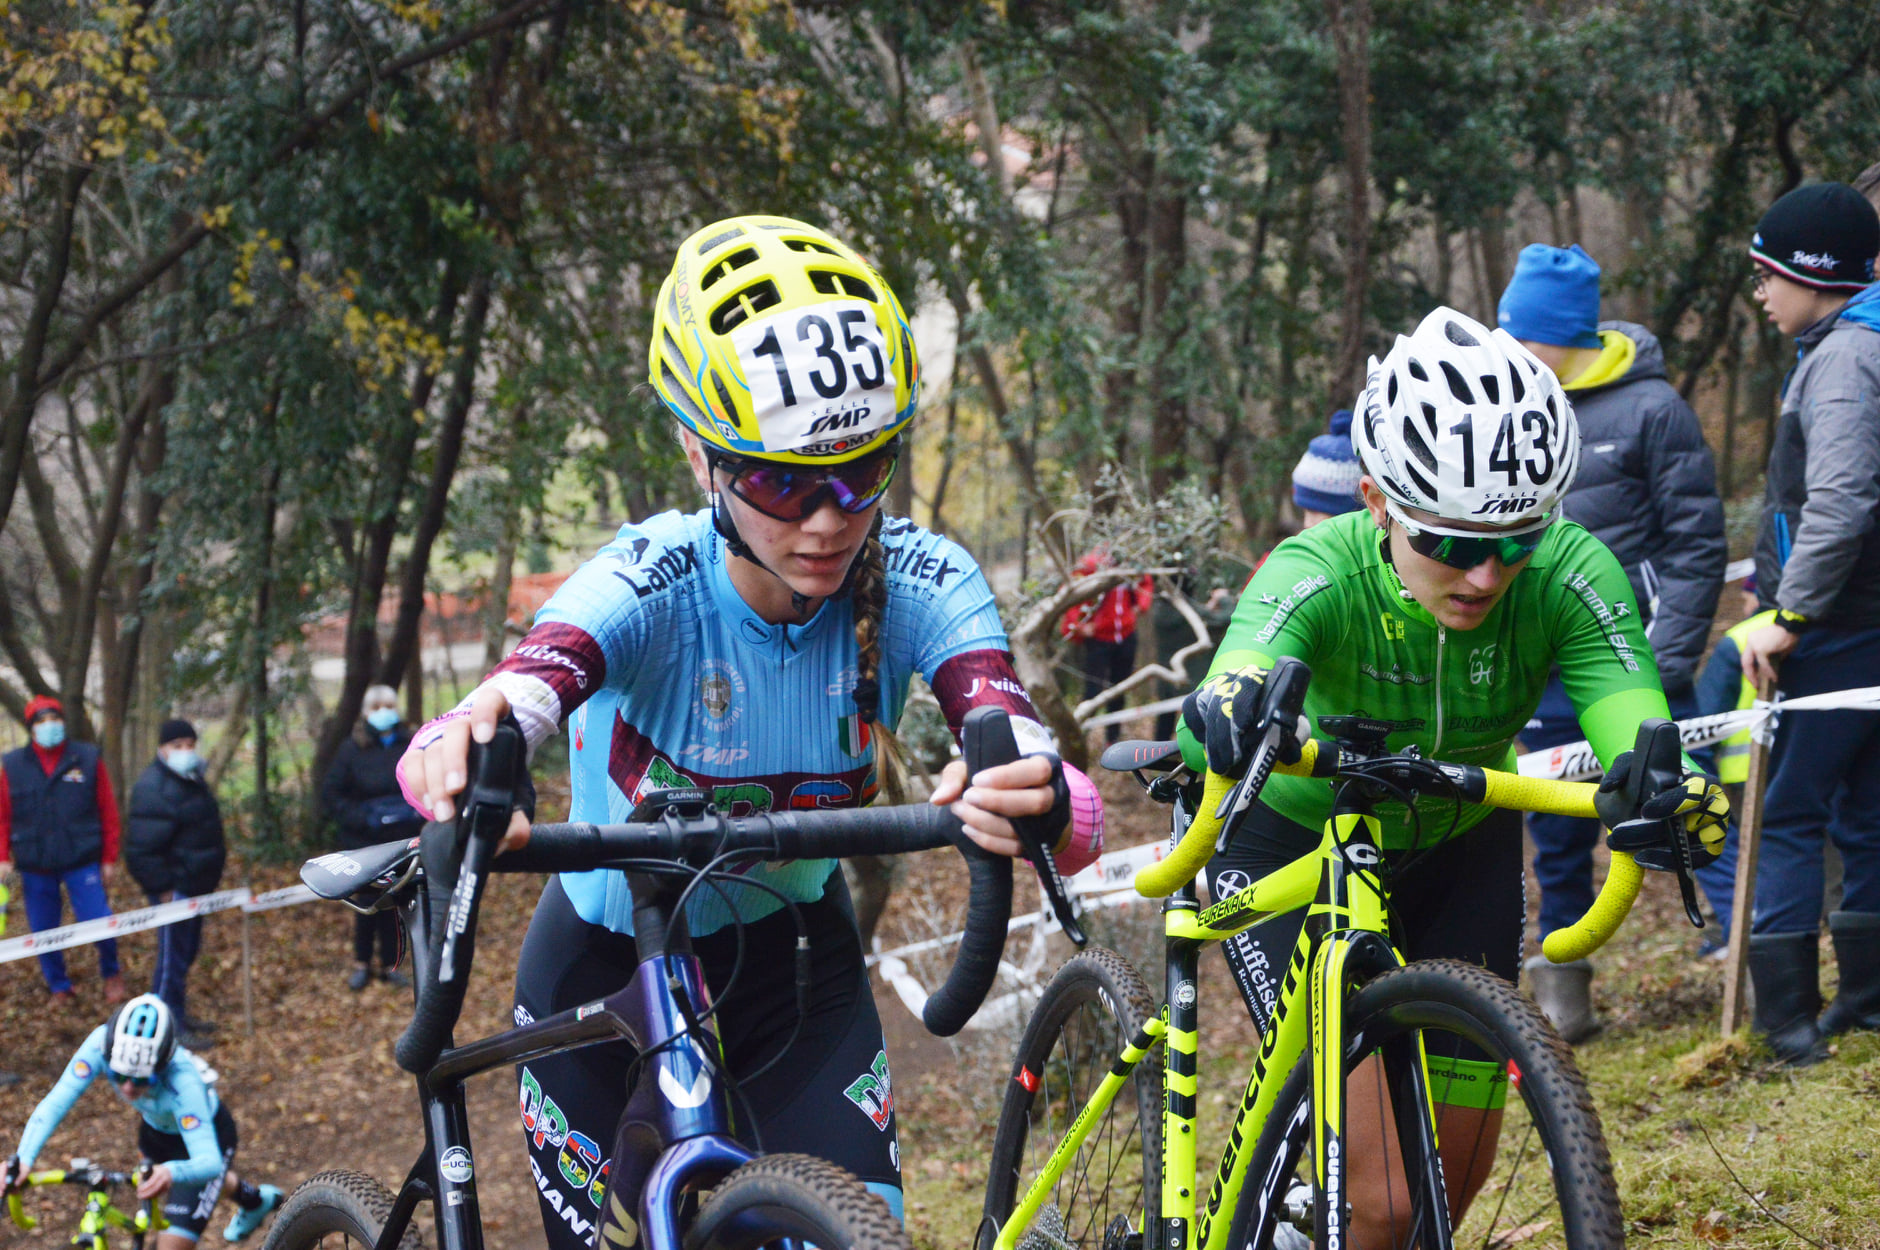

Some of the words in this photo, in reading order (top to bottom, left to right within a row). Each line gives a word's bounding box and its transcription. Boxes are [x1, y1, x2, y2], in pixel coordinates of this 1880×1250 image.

[753, 308, 885, 409] 135
[810, 397, 870, 416] SELLE
[800, 406, 872, 438] SMP
[799, 428, 878, 456] SUOMY
[1449, 410, 1554, 488] 143
[1471, 497, 1538, 515] SMP
[1484, 489, 1540, 500] SELLE
[1357, 721, 1389, 733] GARMIN
[678, 742, 750, 767] SMP
[1244, 743, 1278, 802] SRAM
[666, 791, 704, 801] GARMIN
[454, 870, 478, 935] SRAM
[1235, 930, 1277, 1018] aiffeise
[1237, 967, 1267, 1035] Rosengarte
[450, 1160, 468, 1169] UCI
